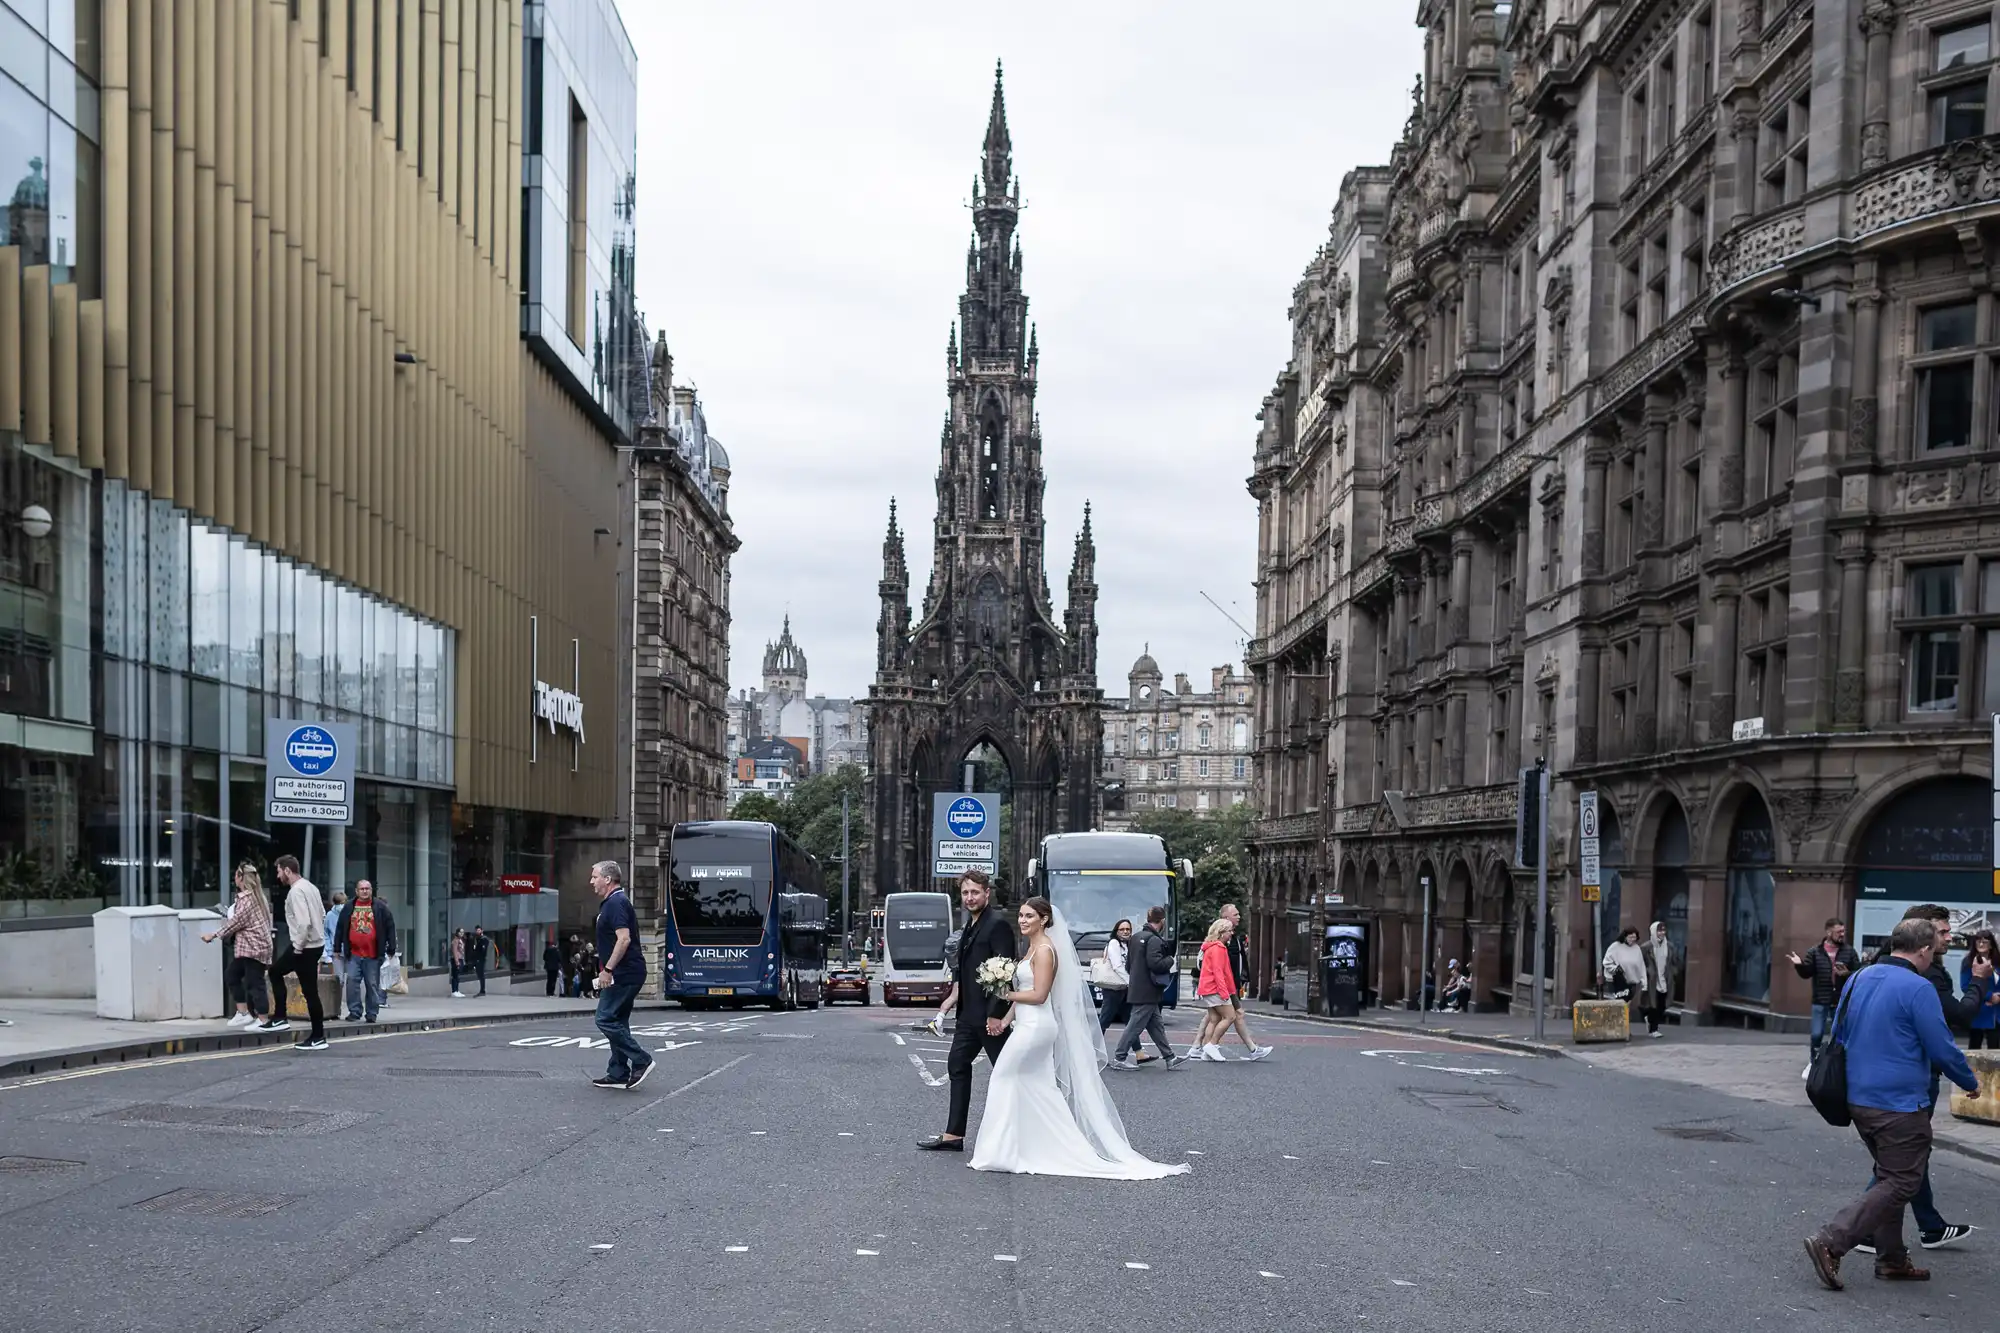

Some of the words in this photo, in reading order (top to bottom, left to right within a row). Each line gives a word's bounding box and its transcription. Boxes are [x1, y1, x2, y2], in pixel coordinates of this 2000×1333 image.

[303, 762, 319, 770] taxi
[297, 781, 343, 790] authorised
[293, 789, 327, 798] vehicles
[716, 868, 743, 878] Airport
[692, 949, 749, 958] AIRLINK
[509, 1037, 703, 1052] ONY
